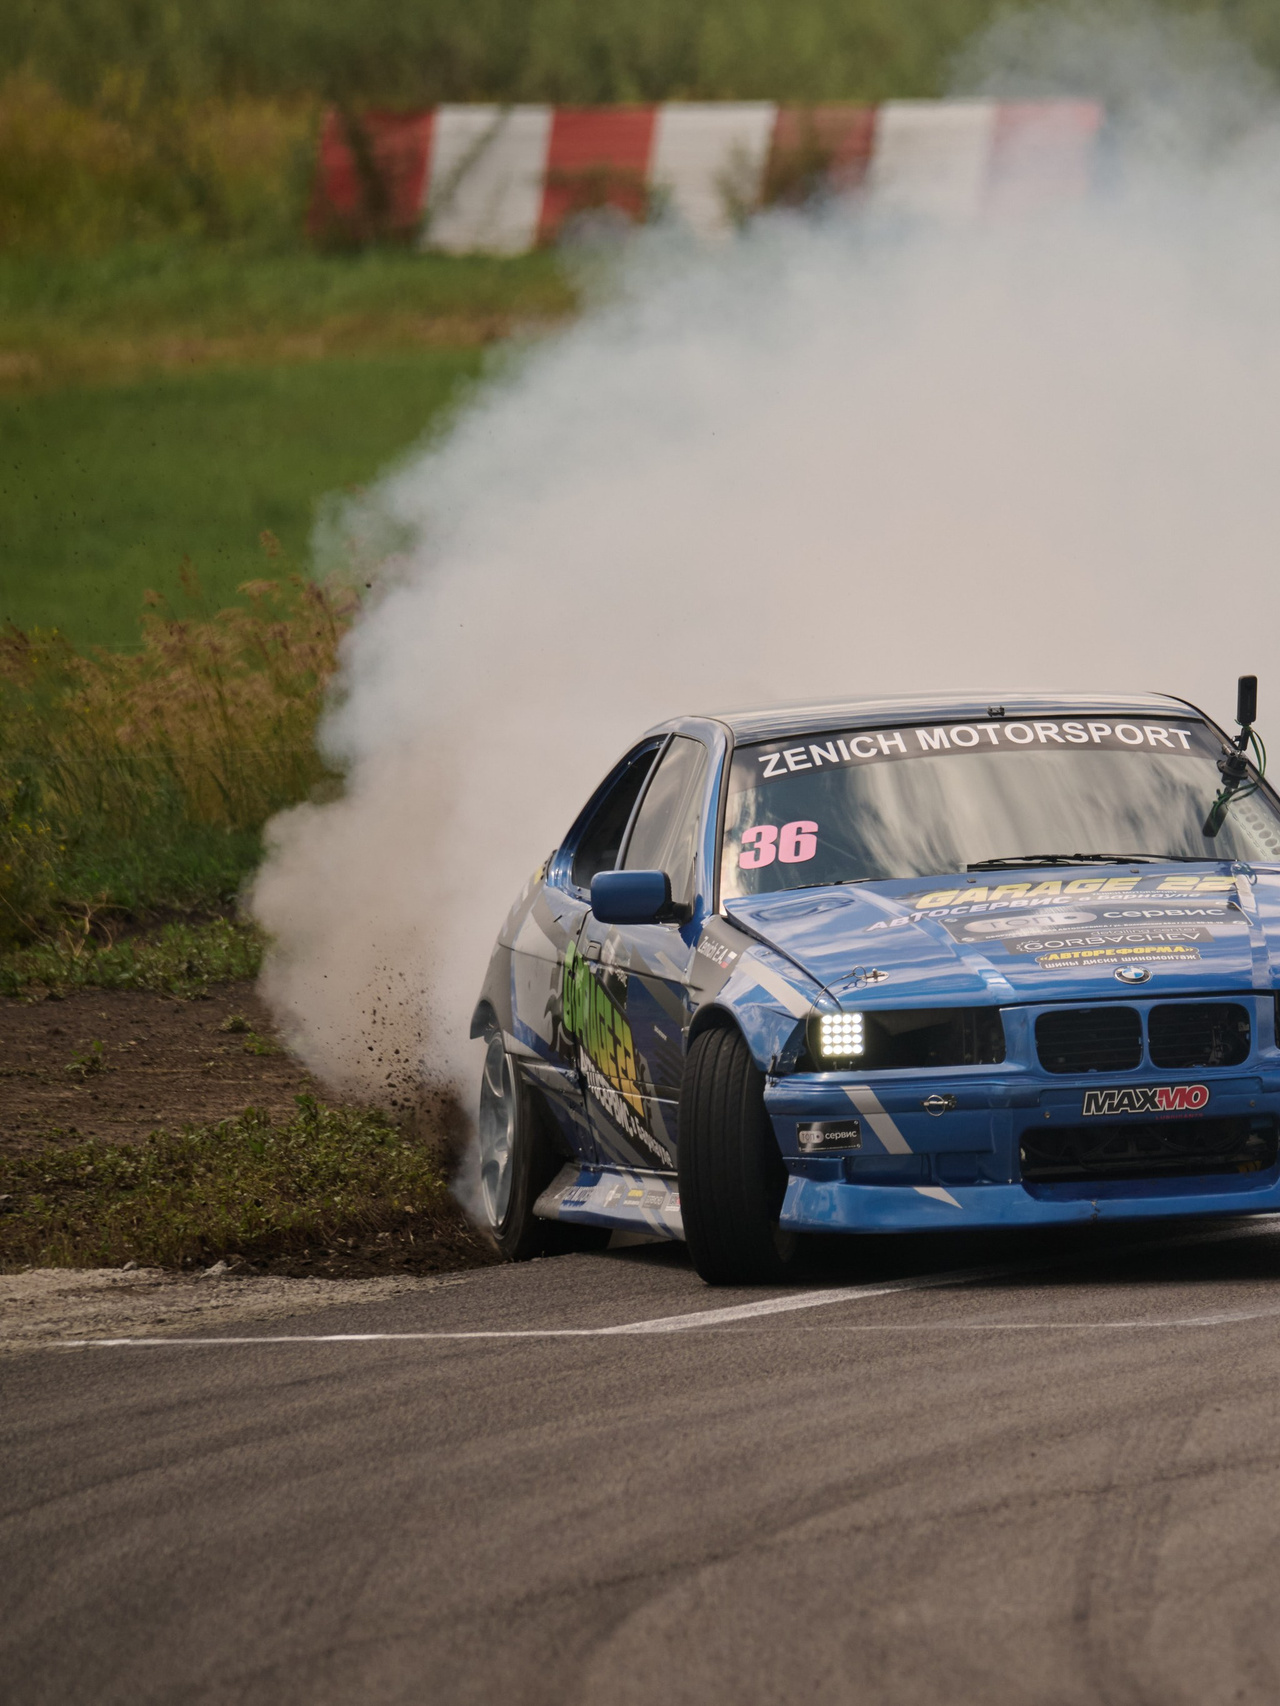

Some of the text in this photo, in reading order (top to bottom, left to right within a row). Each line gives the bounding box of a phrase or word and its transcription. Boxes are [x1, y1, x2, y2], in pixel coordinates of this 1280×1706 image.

[757, 721, 1194, 780] ZENICH MOTORSPORT
[738, 820, 819, 870] 36
[914, 875, 1239, 910] GARAGE 22
[865, 895, 1073, 932] АВТОСЕРВИС
[981, 907, 1227, 929] ТОП сервис
[1020, 932, 1202, 951] GORBACHEV
[1090, 925, 1199, 937] detailing center
[697, 935, 720, 960] Zenich
[1081, 1084, 1211, 1117] MAXMO
[824, 1130, 858, 1141] сервис
